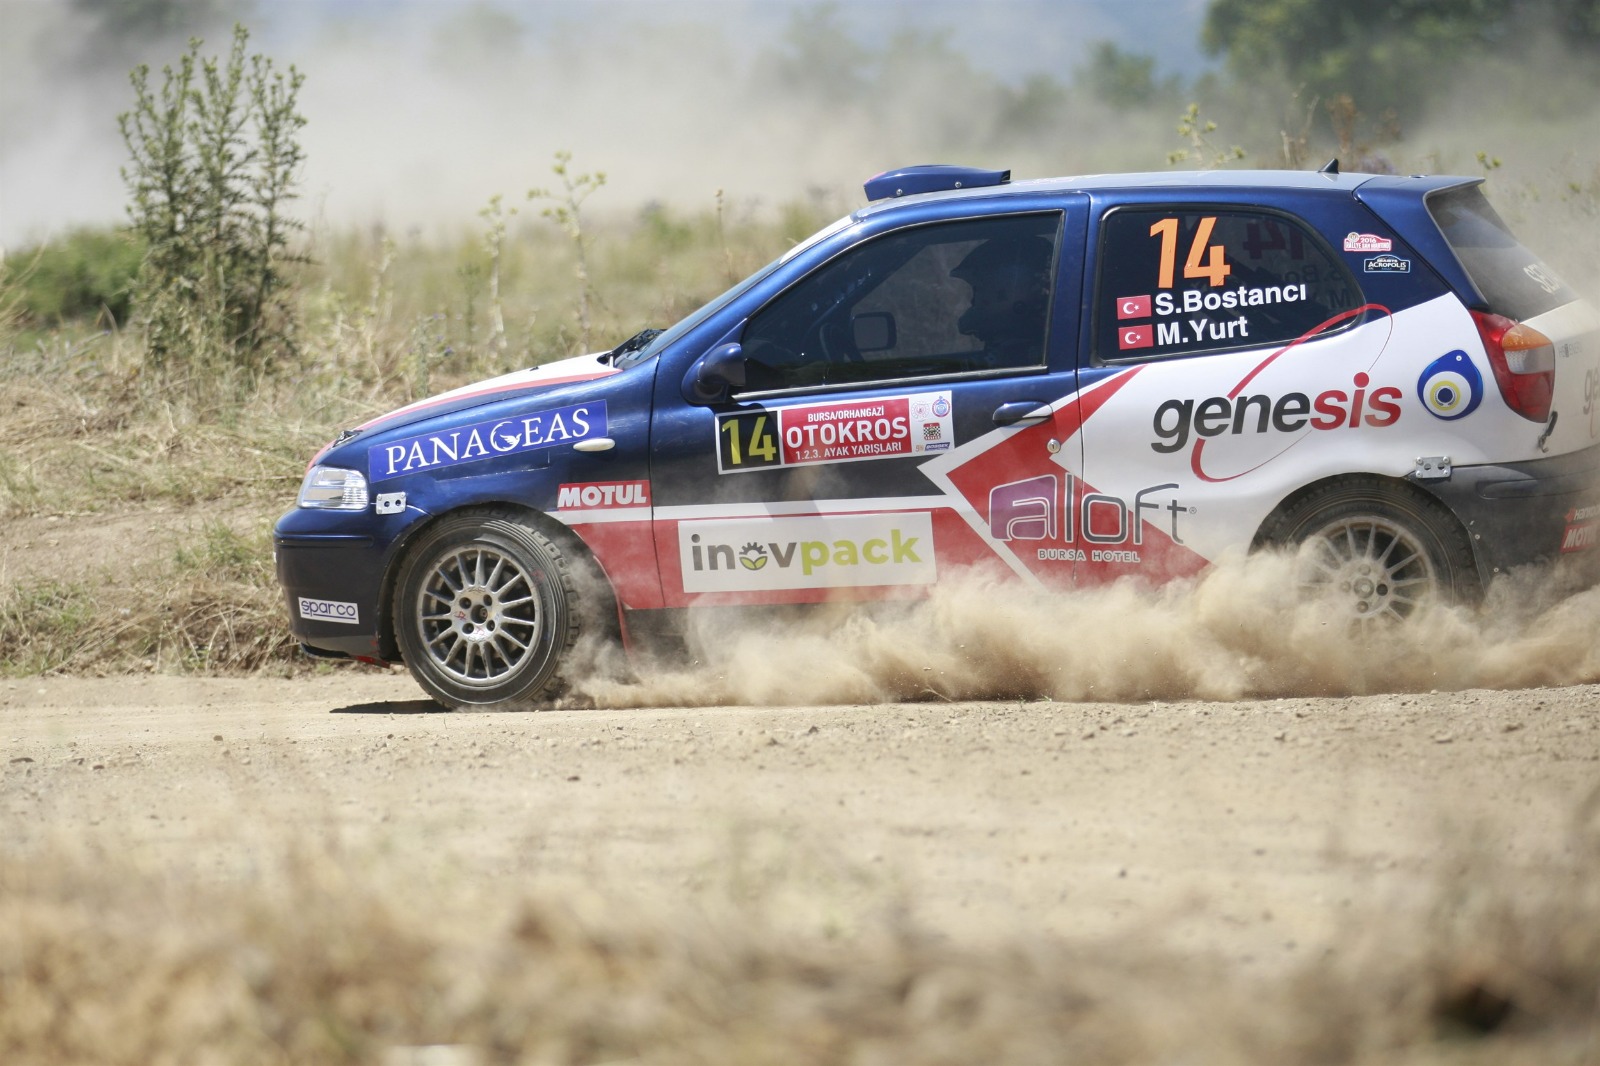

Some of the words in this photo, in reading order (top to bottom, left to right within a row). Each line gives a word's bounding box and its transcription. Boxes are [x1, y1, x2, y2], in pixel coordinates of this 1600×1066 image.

[1150, 216, 1231, 289] 14
[1155, 283, 1306, 316] S.Bostancı
[1157, 316, 1248, 346] M.Yurt
[807, 405, 885, 423] BURSA/ORHANGAZİ
[1151, 371, 1402, 454] genesis
[386, 407, 591, 475] PANAGEAS
[721, 416, 777, 465] 14
[786, 416, 909, 449] OTOKROS
[795, 449, 822, 461] 1.2.3.
[823, 447, 850, 458] AYAK
[851, 442, 902, 455] YARIŞLARI
[557, 485, 647, 508] MOTUL
[691, 529, 923, 576] inovpack
[1038, 548, 1087, 562] BURSA
[1091, 549, 1141, 563] HOTEL
[301, 600, 356, 617] sparco
